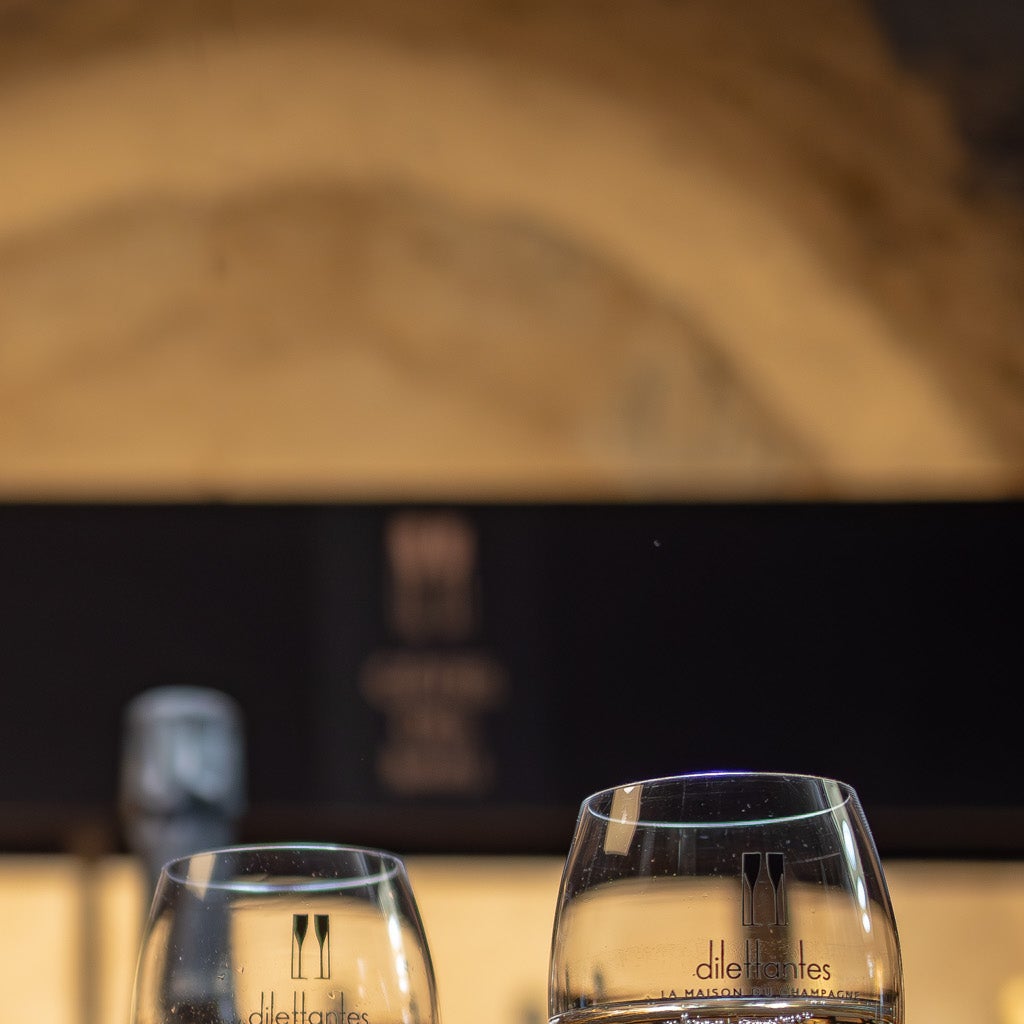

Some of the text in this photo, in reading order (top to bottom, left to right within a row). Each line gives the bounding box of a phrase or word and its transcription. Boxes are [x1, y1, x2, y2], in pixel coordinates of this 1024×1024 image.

[696, 939, 831, 981] dilettantes
[684, 988, 742, 998] MAISON
[779, 987, 861, 999] CHAMPAGNE
